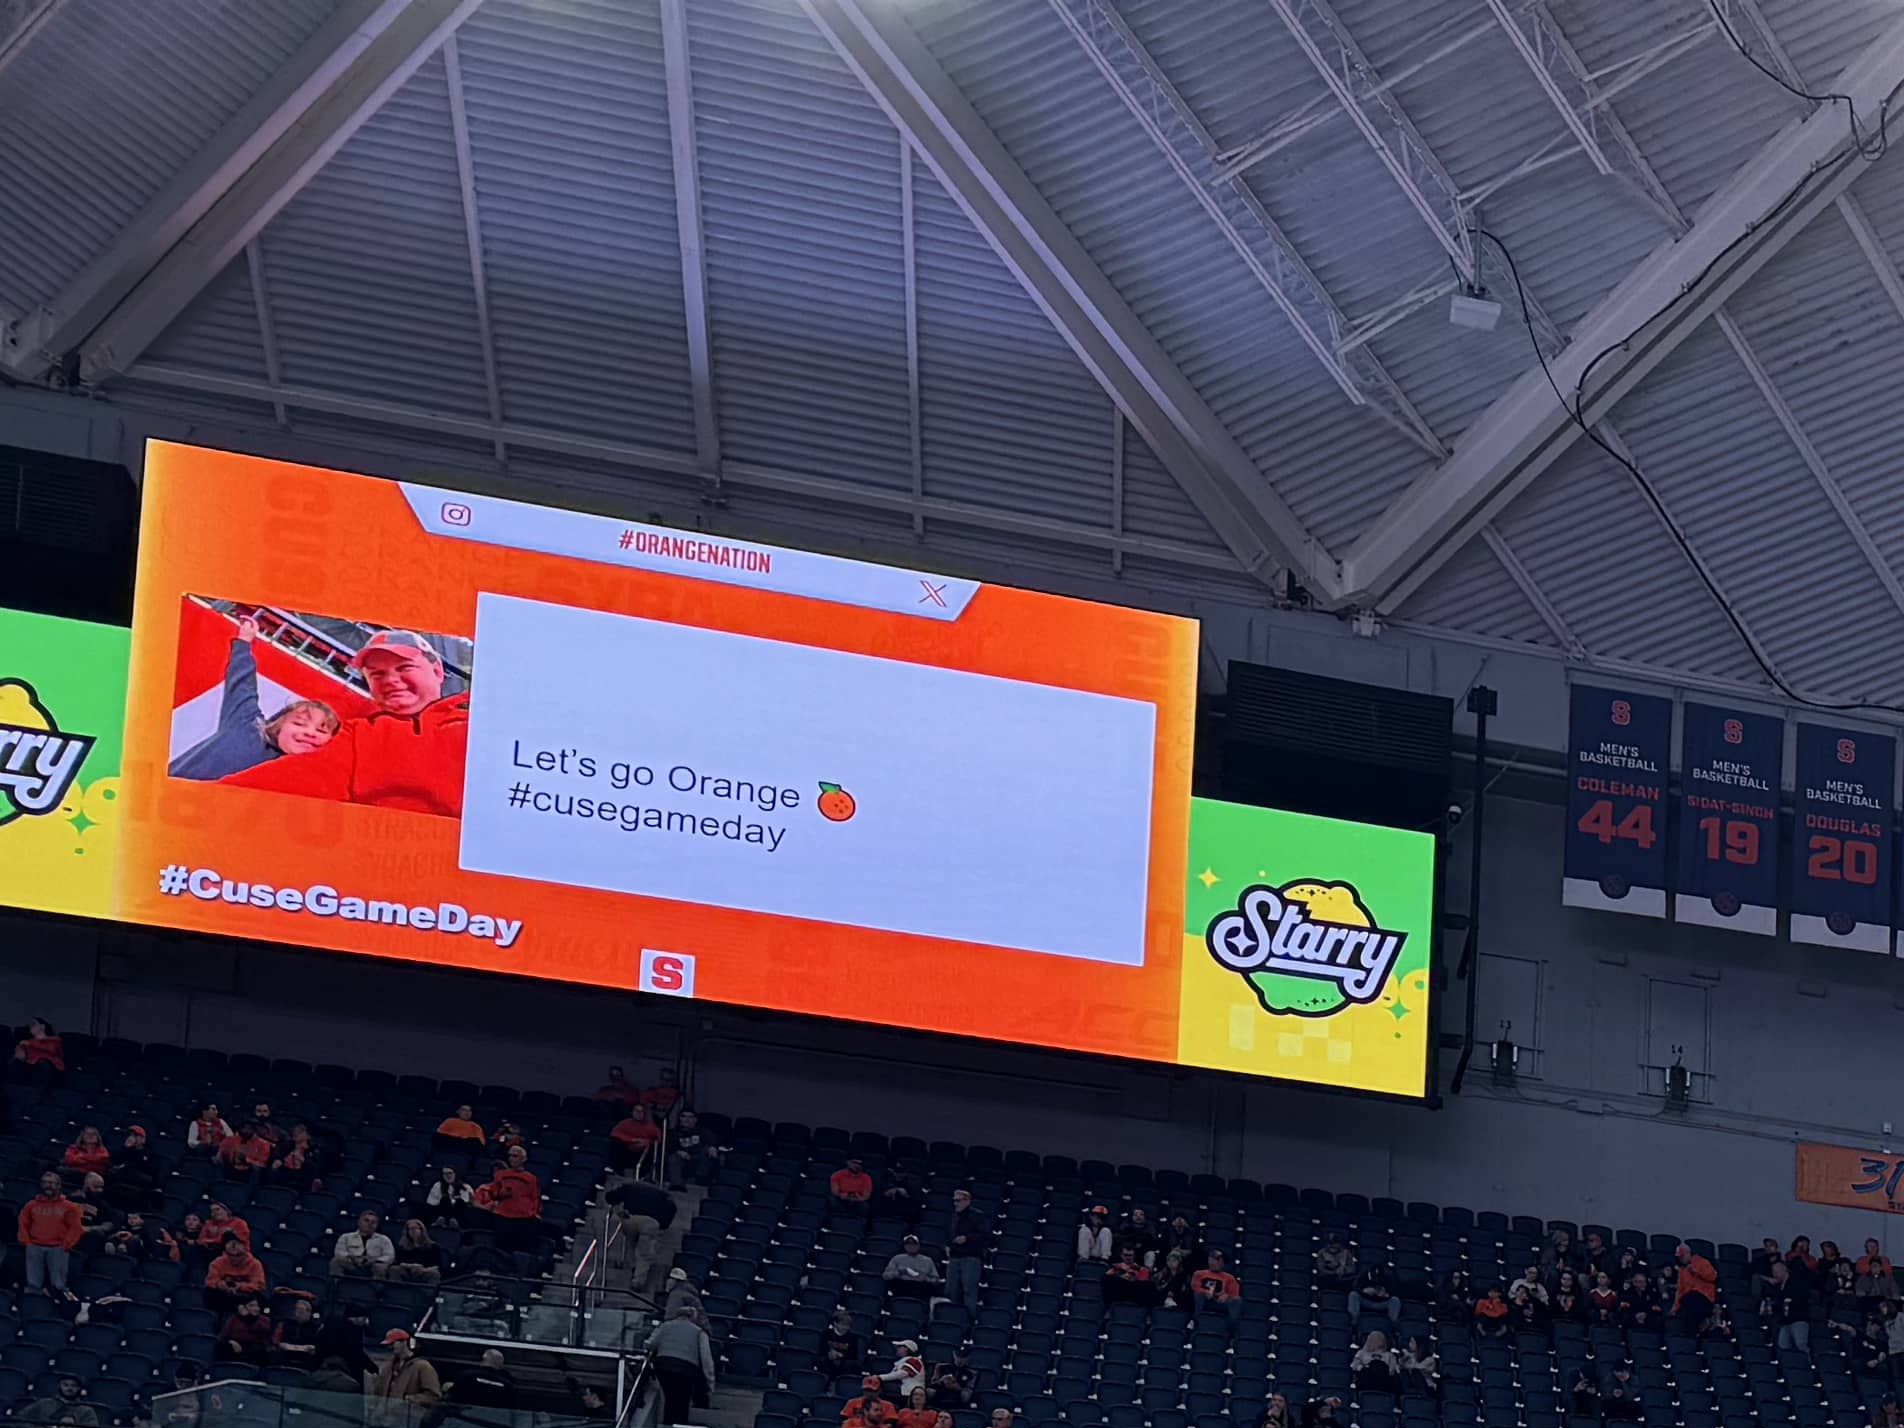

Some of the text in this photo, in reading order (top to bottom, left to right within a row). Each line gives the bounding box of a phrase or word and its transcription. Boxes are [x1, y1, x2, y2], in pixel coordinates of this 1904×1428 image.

[618, 530, 772, 575] #ORANGENATION
[1579, 750, 1659, 773] BASKETBALL
[1600, 742, 1639, 758] MEN'S
[1712, 759, 1751, 776] MEN'S
[610, 760, 656, 791] go
[667, 764, 802, 812] Orange
[1577, 776, 1661, 801] COLEMAN
[1692, 768, 1769, 791] BASKETBALL
[1826, 780, 1864, 796] MEN'S
[508, 783, 788, 853] #cusegameday
[1806, 788, 1882, 811] BASKETBALL
[1577, 799, 1656, 849] 44
[1700, 816, 1760, 865] 19
[1806, 814, 1882, 838] DOUGLAS
[1807, 834, 1878, 885] 20
[158, 864, 523, 948] #CuseGameDay
[1213, 889, 1398, 1000] Starry
[651, 955, 684, 992] S
